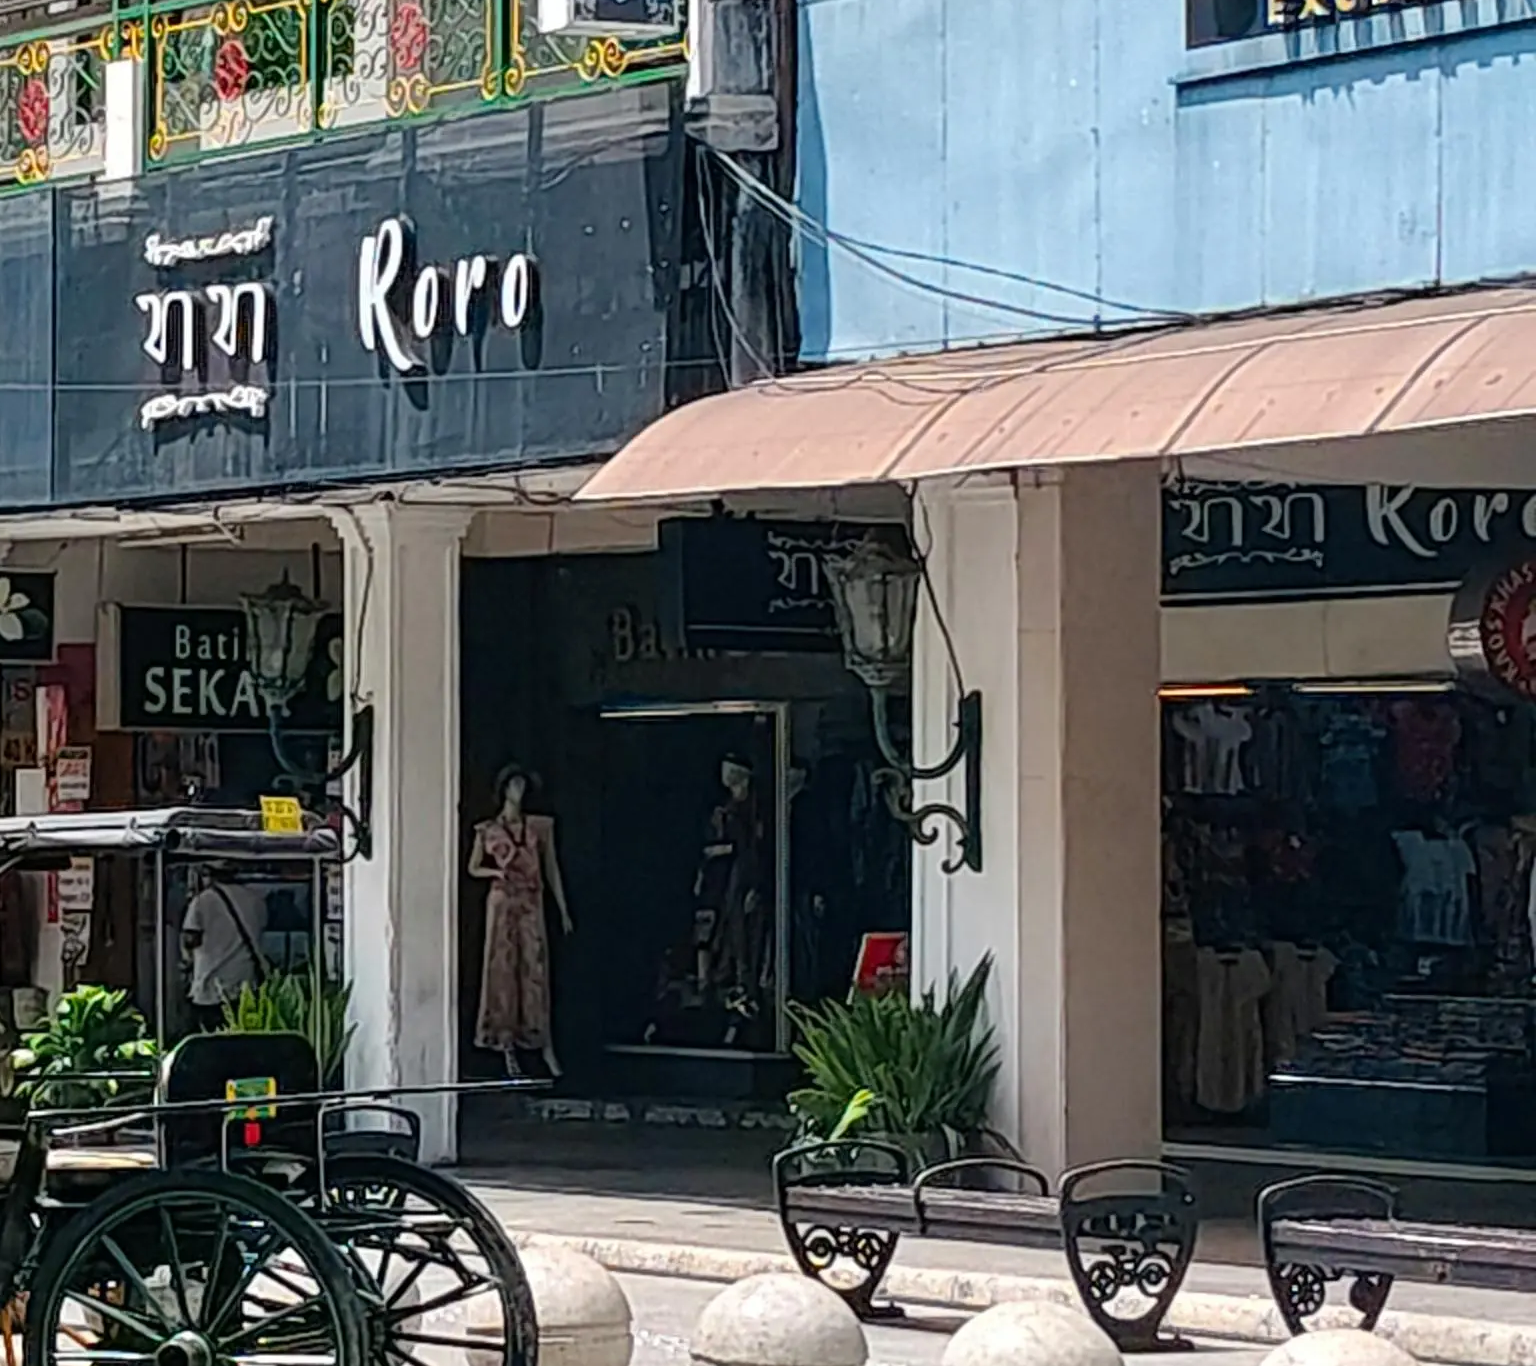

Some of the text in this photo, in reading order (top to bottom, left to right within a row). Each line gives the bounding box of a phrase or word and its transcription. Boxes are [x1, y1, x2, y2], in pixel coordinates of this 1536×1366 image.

[357, 217, 531, 372] Roro
[174, 623, 250, 661] Bati
[143, 666, 290, 718] SEKA
